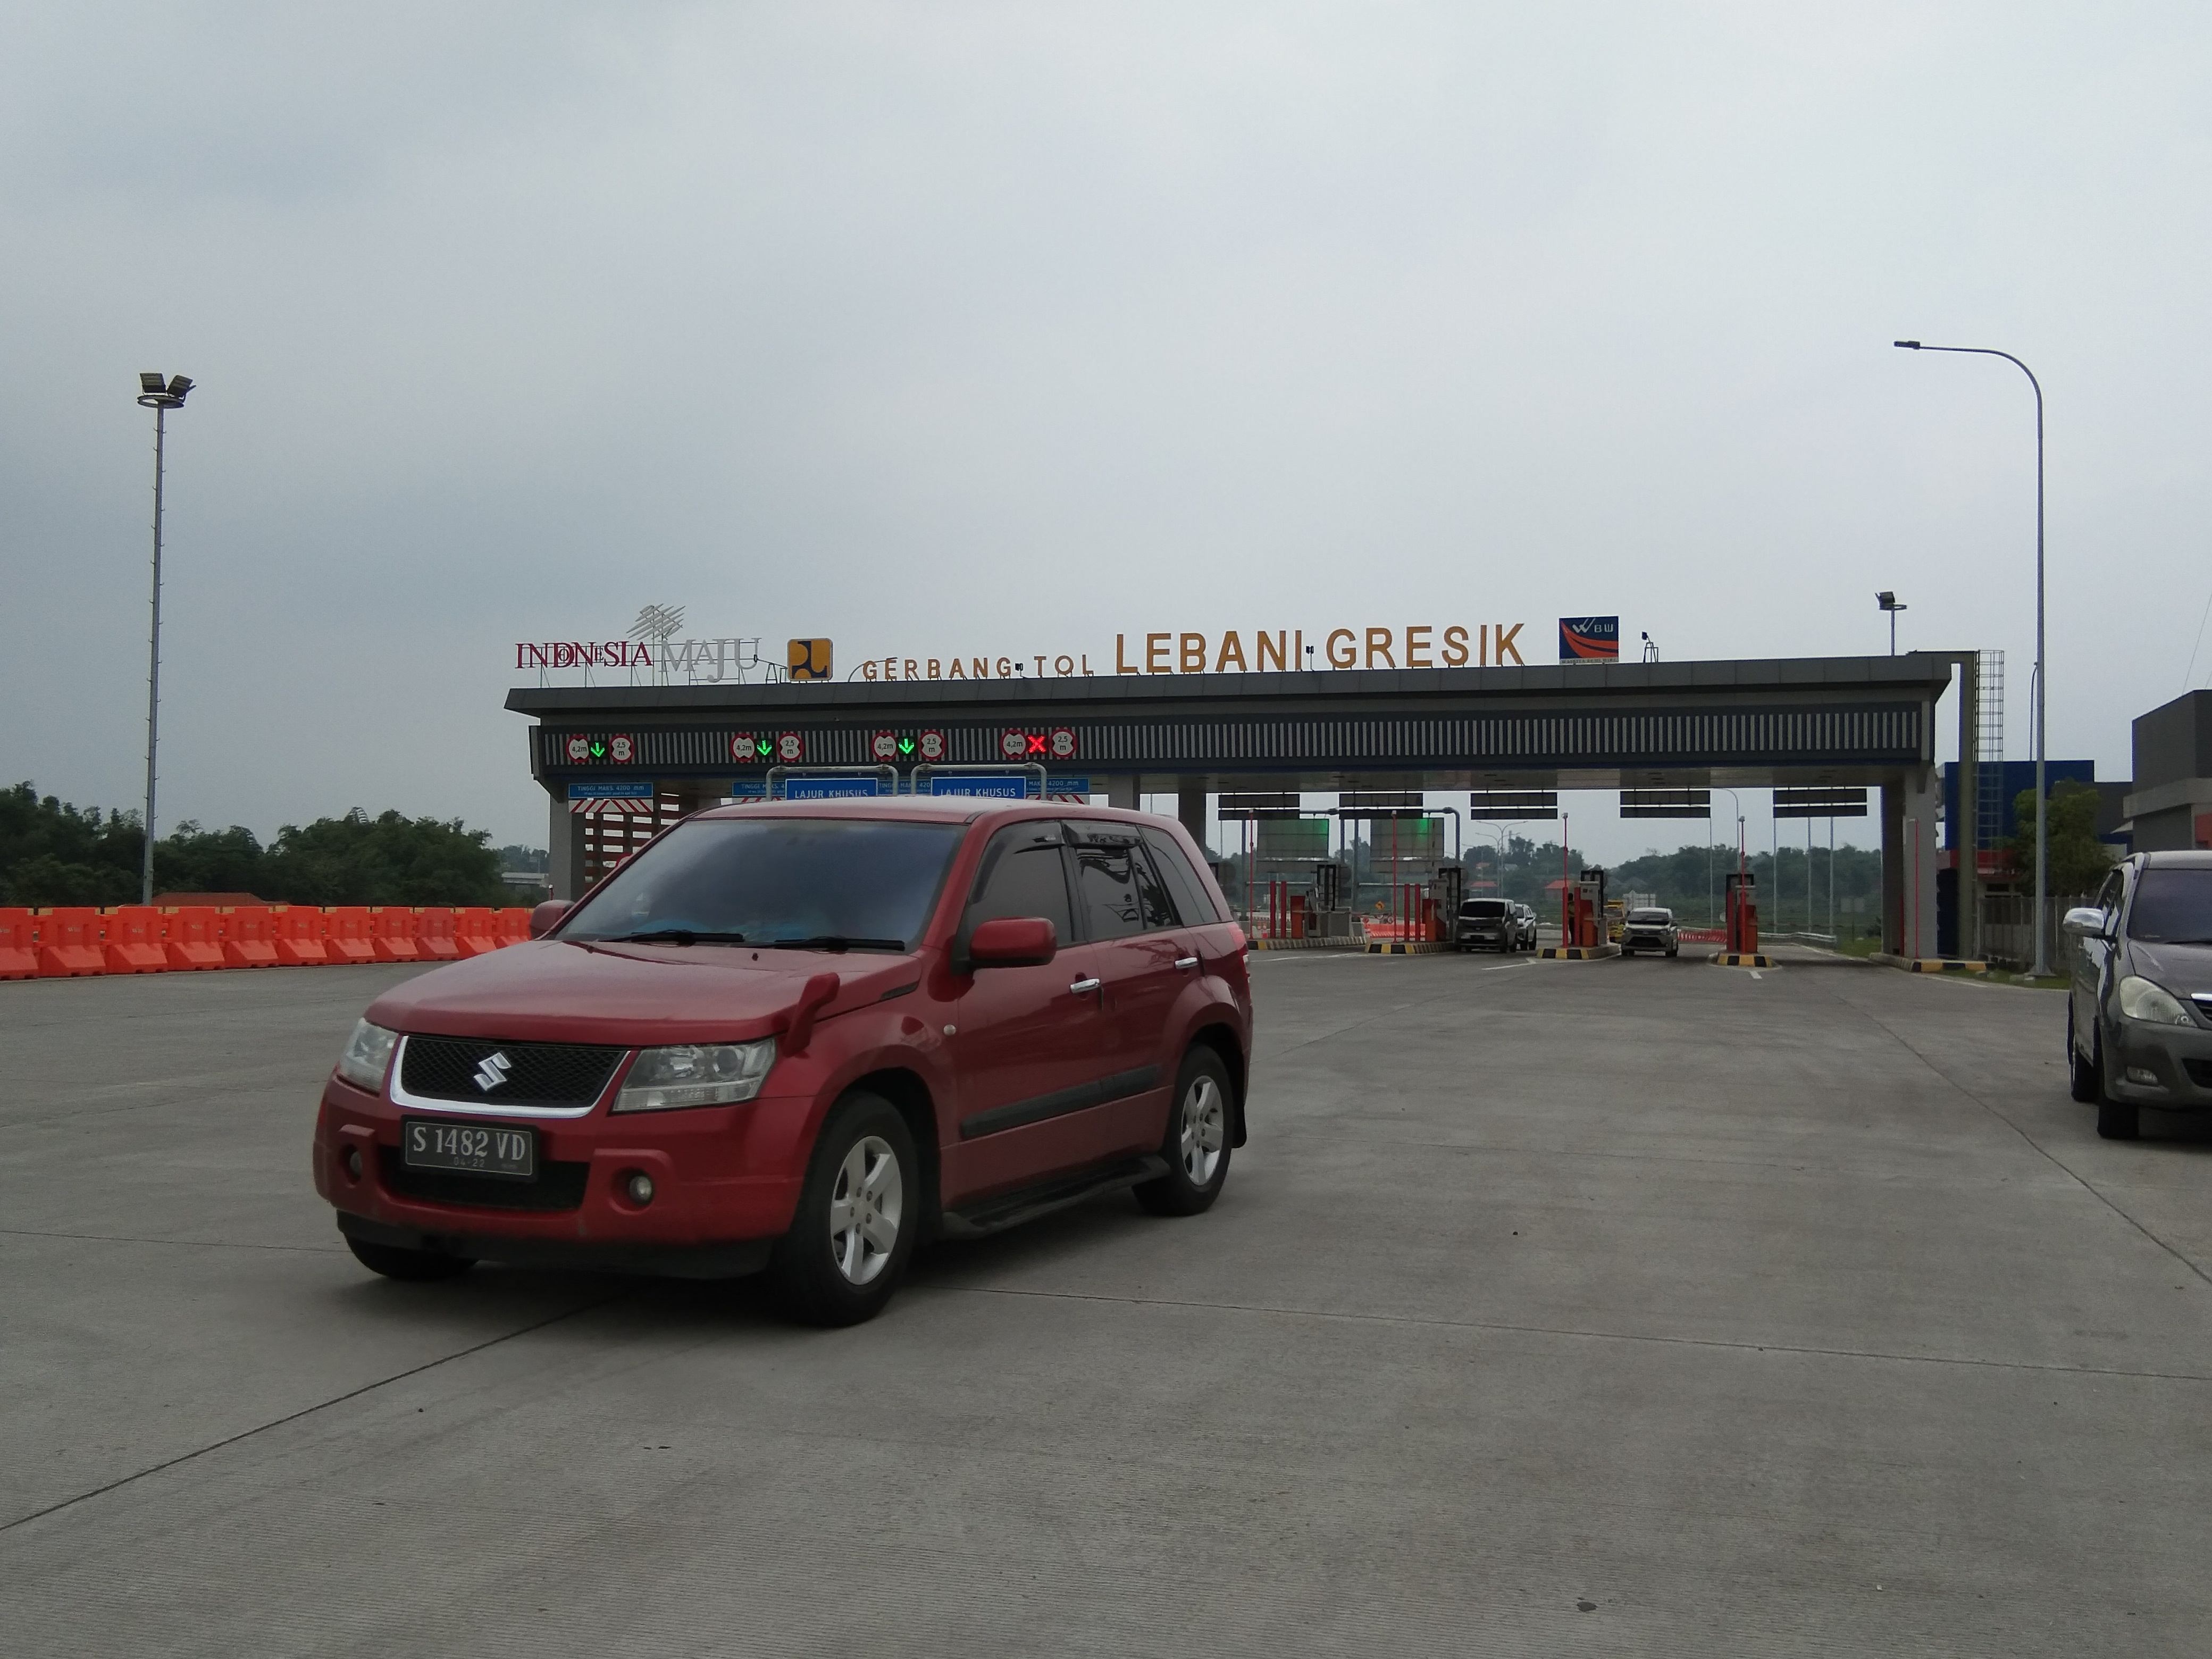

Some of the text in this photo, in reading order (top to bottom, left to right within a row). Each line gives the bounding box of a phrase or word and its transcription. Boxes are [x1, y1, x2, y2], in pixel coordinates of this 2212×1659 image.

[658, 638, 762, 683] MAJU
[862, 623, 1524, 680] GERBANG TOL LEBANI GRESIK
[794, 790, 824, 799] LAJUR
[829, 789, 868, 798] KHUSUS
[976, 788, 1016, 797] KHUSUS
[413, 1126, 525, 1160] S 1482 VD
